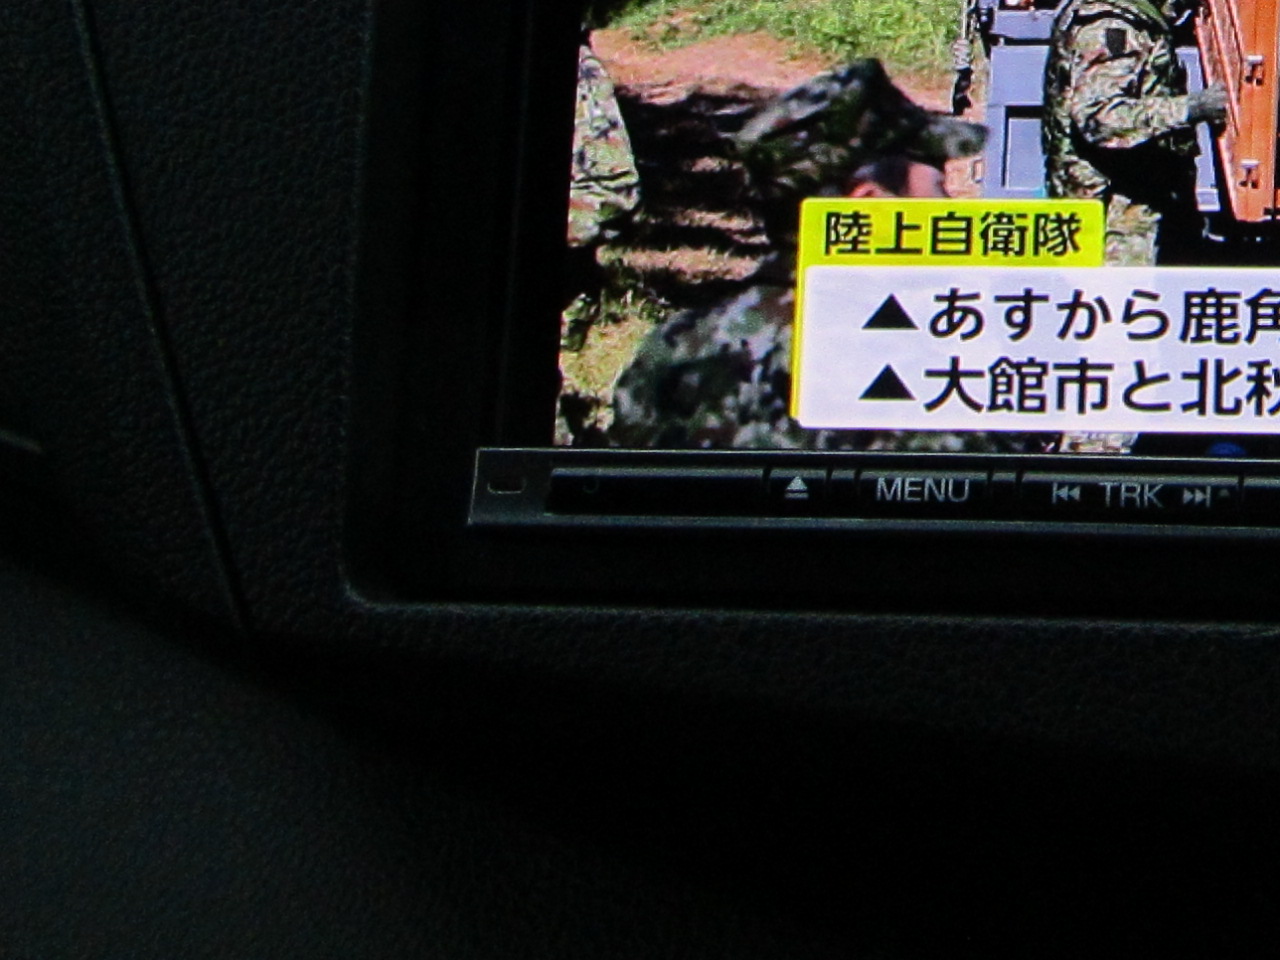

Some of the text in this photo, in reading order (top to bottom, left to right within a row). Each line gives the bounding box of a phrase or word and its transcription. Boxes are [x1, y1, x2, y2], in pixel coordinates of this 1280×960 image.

[822, 212, 1083, 258] 陸上自衛隊
[875, 477, 972, 503] MENU
[1097, 482, 1165, 510] TRK
